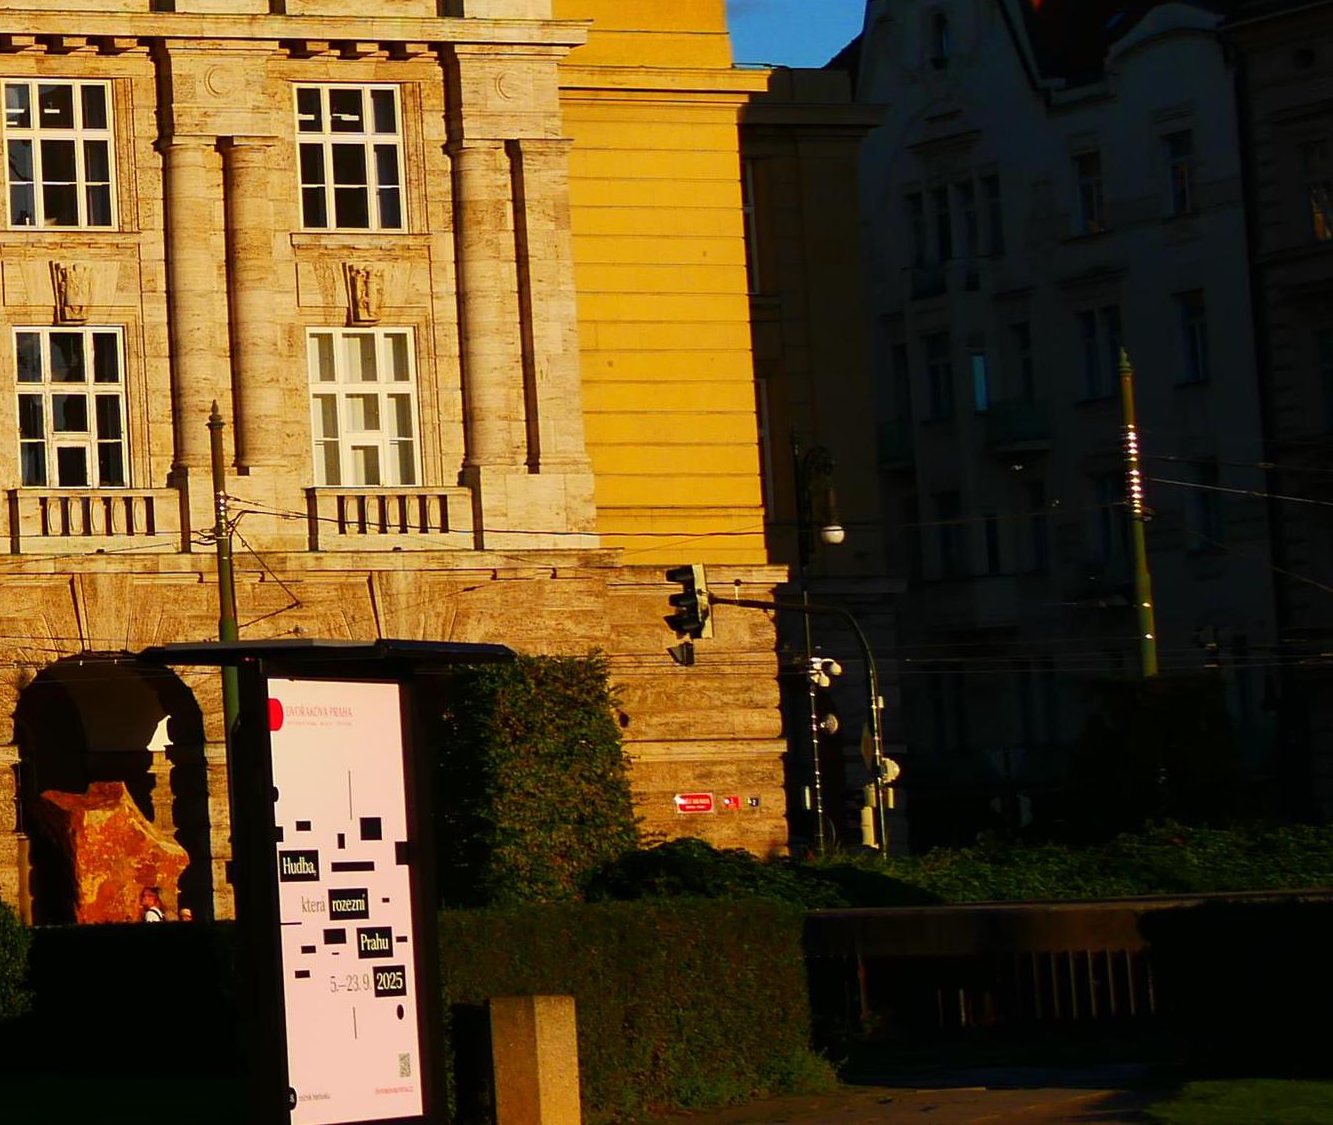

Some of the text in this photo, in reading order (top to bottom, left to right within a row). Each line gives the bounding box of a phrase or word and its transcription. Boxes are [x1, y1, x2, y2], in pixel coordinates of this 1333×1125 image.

[282, 856, 317, 877] Hudba,
[301, 893, 366, 913] která rozezní
[360, 932, 390, 951] Prahu
[376, 971, 404, 991] 2025
